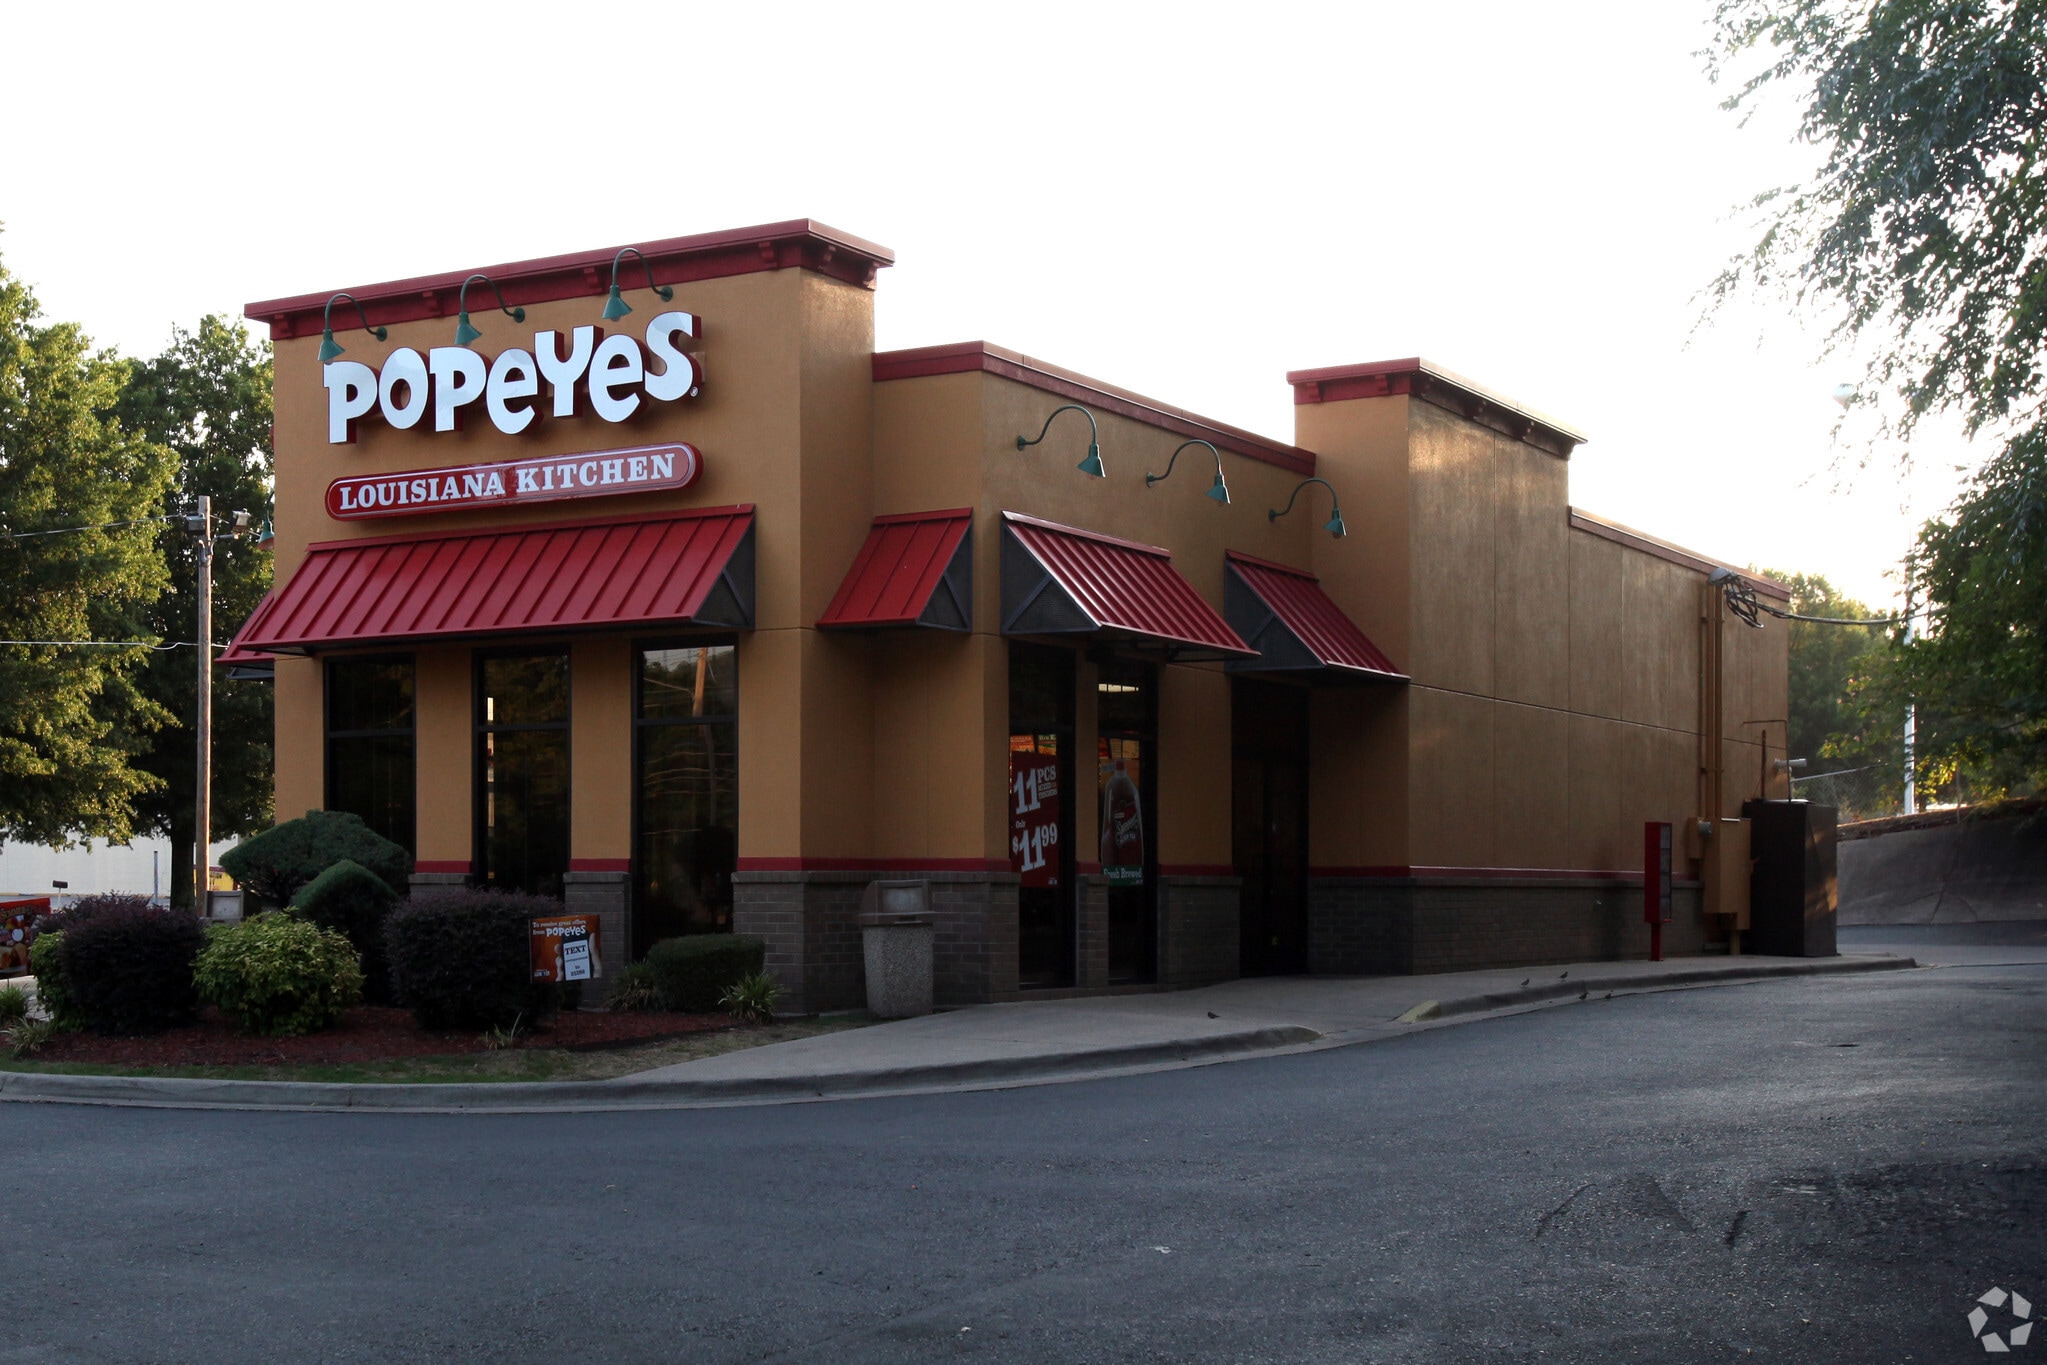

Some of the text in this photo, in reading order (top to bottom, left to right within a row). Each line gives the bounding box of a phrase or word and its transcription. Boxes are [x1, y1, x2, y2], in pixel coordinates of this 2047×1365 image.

[339, 453, 675, 511] LOUISIANA KITCHEN
[1013, 765, 1056, 815] 11 PCS
[1120, 867, 1142, 879] Brewed
[565, 945, 586, 955] TEXT
